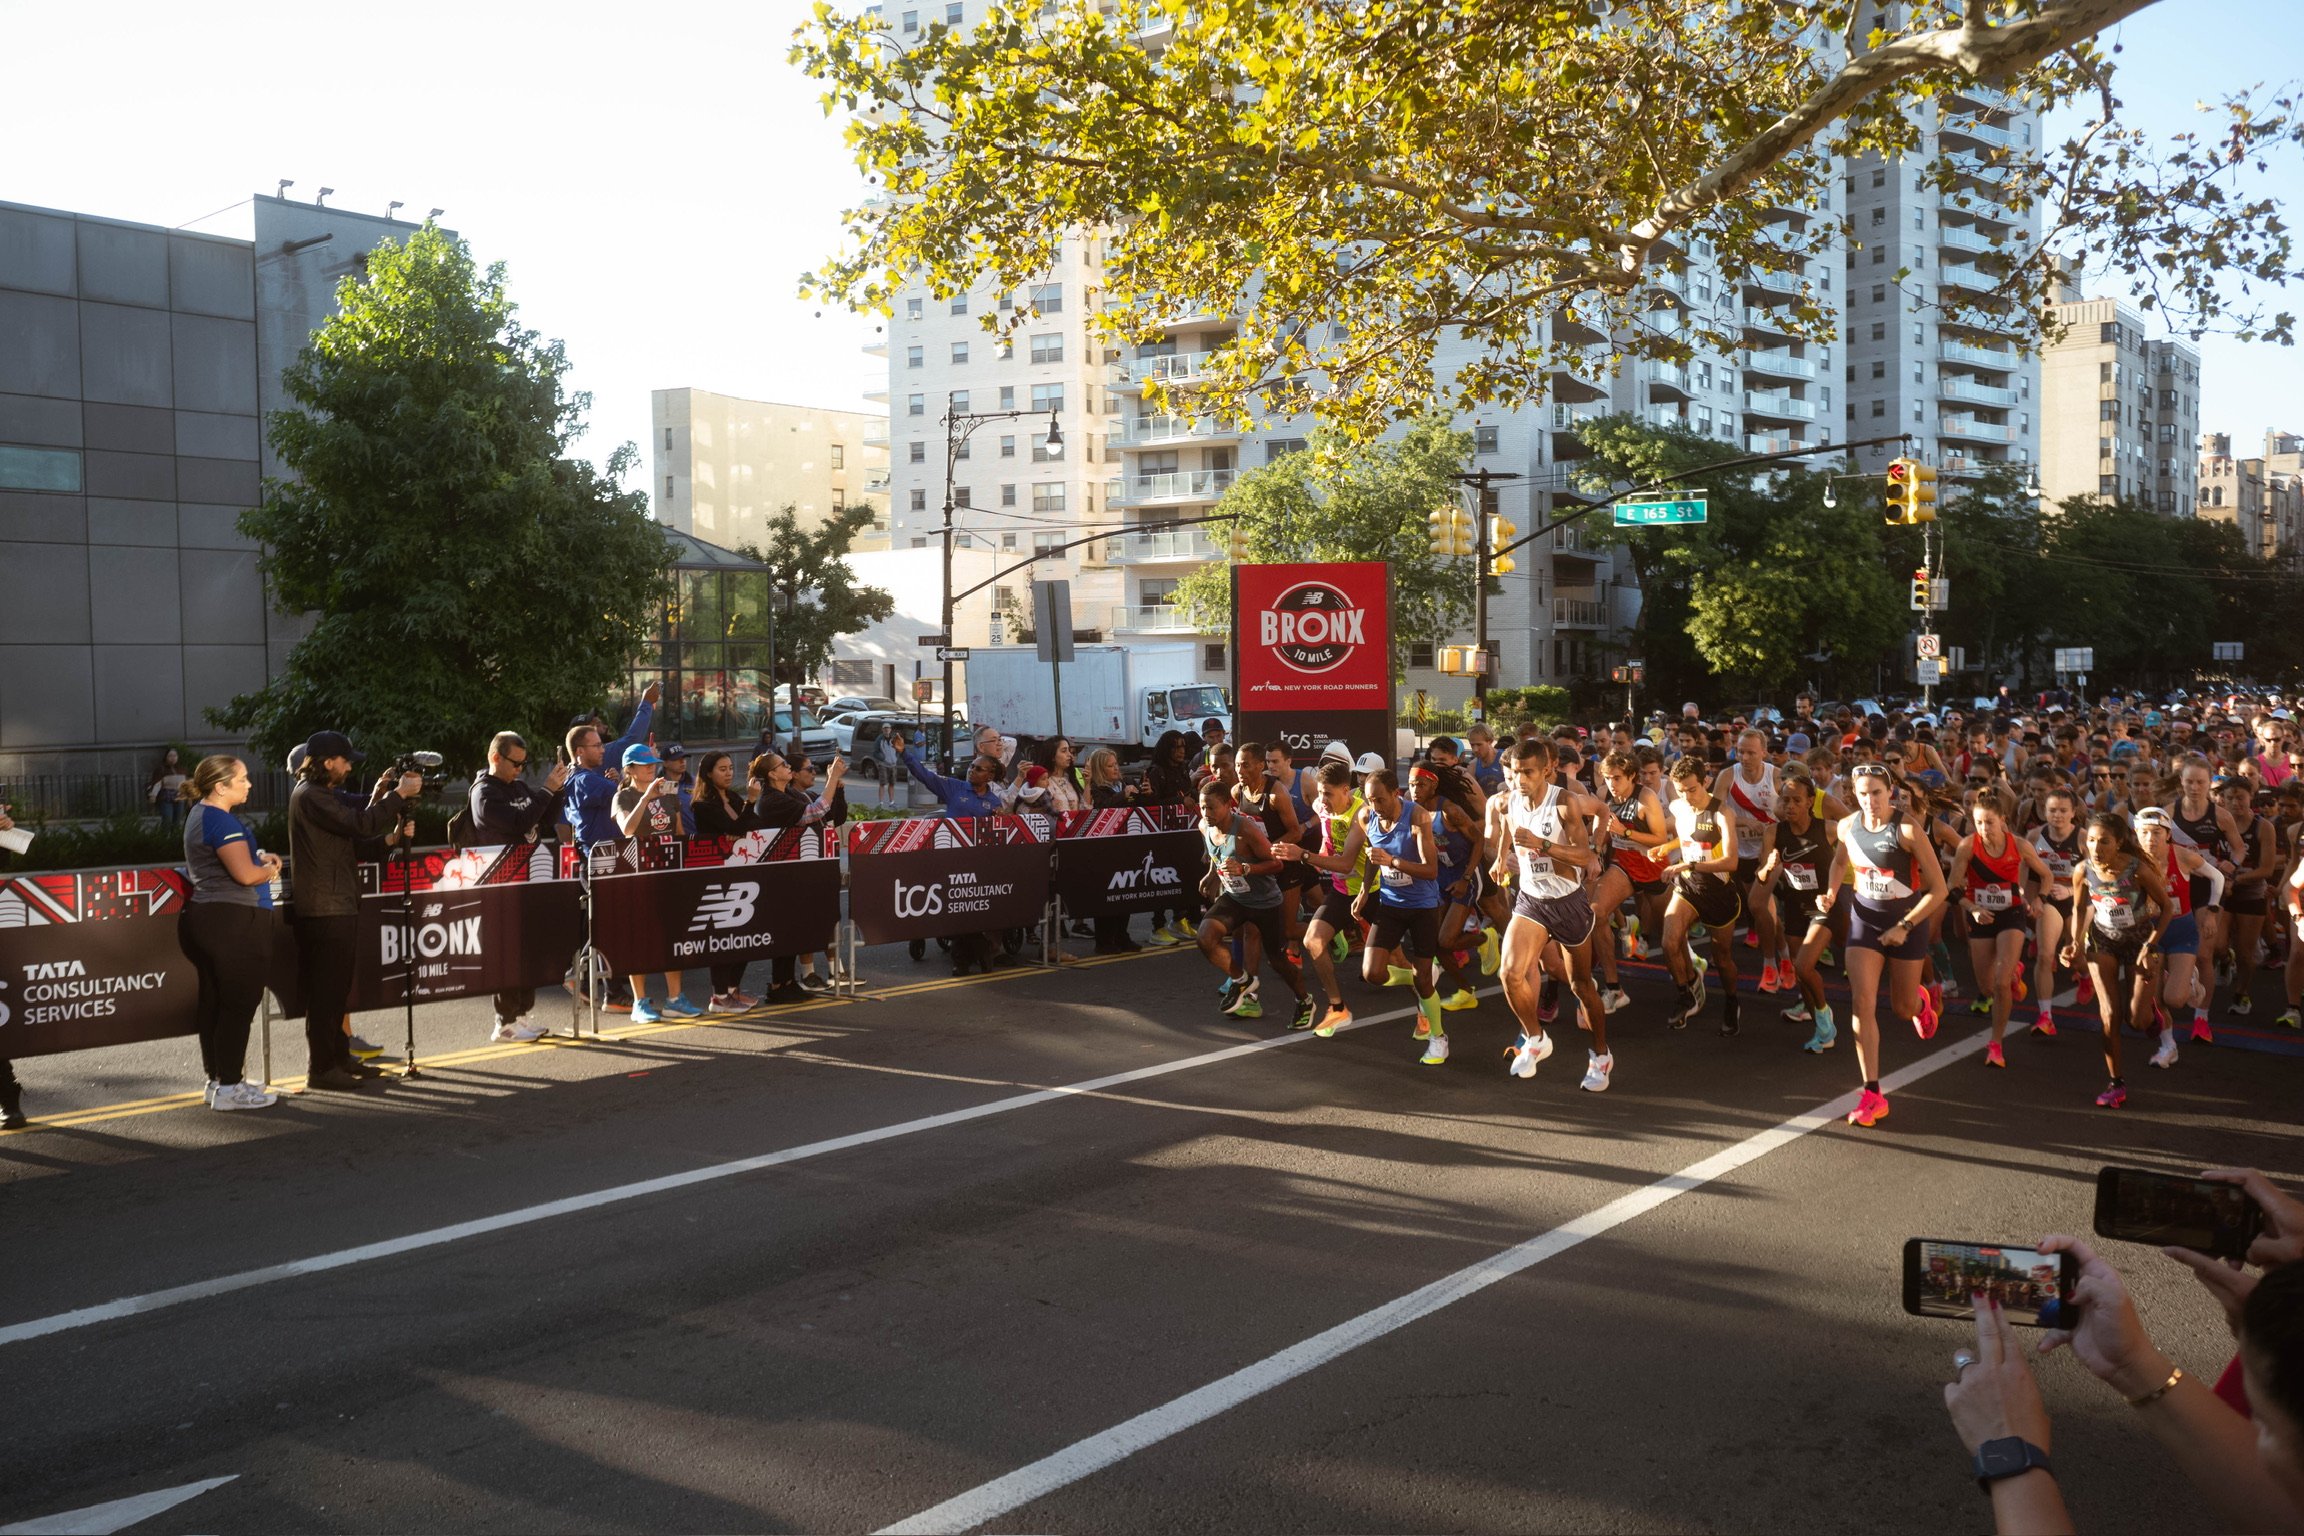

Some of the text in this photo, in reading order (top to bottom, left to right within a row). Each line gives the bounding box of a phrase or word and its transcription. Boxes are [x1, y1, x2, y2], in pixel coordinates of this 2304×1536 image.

[1626, 506, 1693, 520] E 165 St
[1260, 608, 1366, 647] BRONX
[991, 634, 1002, 643] 25
[1294, 648, 1334, 663] 10 MILE
[948, 872, 977, 885] TATA
[894, 878, 943, 918] tcs
[948, 883, 1014, 900] CONSULTANCY
[1122, 893, 1138, 901] YORK
[1139, 891, 1155, 899] ROAD
[1156, 888, 1182, 897] RUNNERS
[948, 899, 990, 914] SERVICES
[381, 915, 482, 966] BRONX
[673, 932, 772, 957] new balance
[22, 960, 86, 981] TATA
[418, 962, 449, 978] 10 MILE
[23, 971, 166, 1003] CONSULTANCY
[23, 998, 117, 1025] SERVICES
